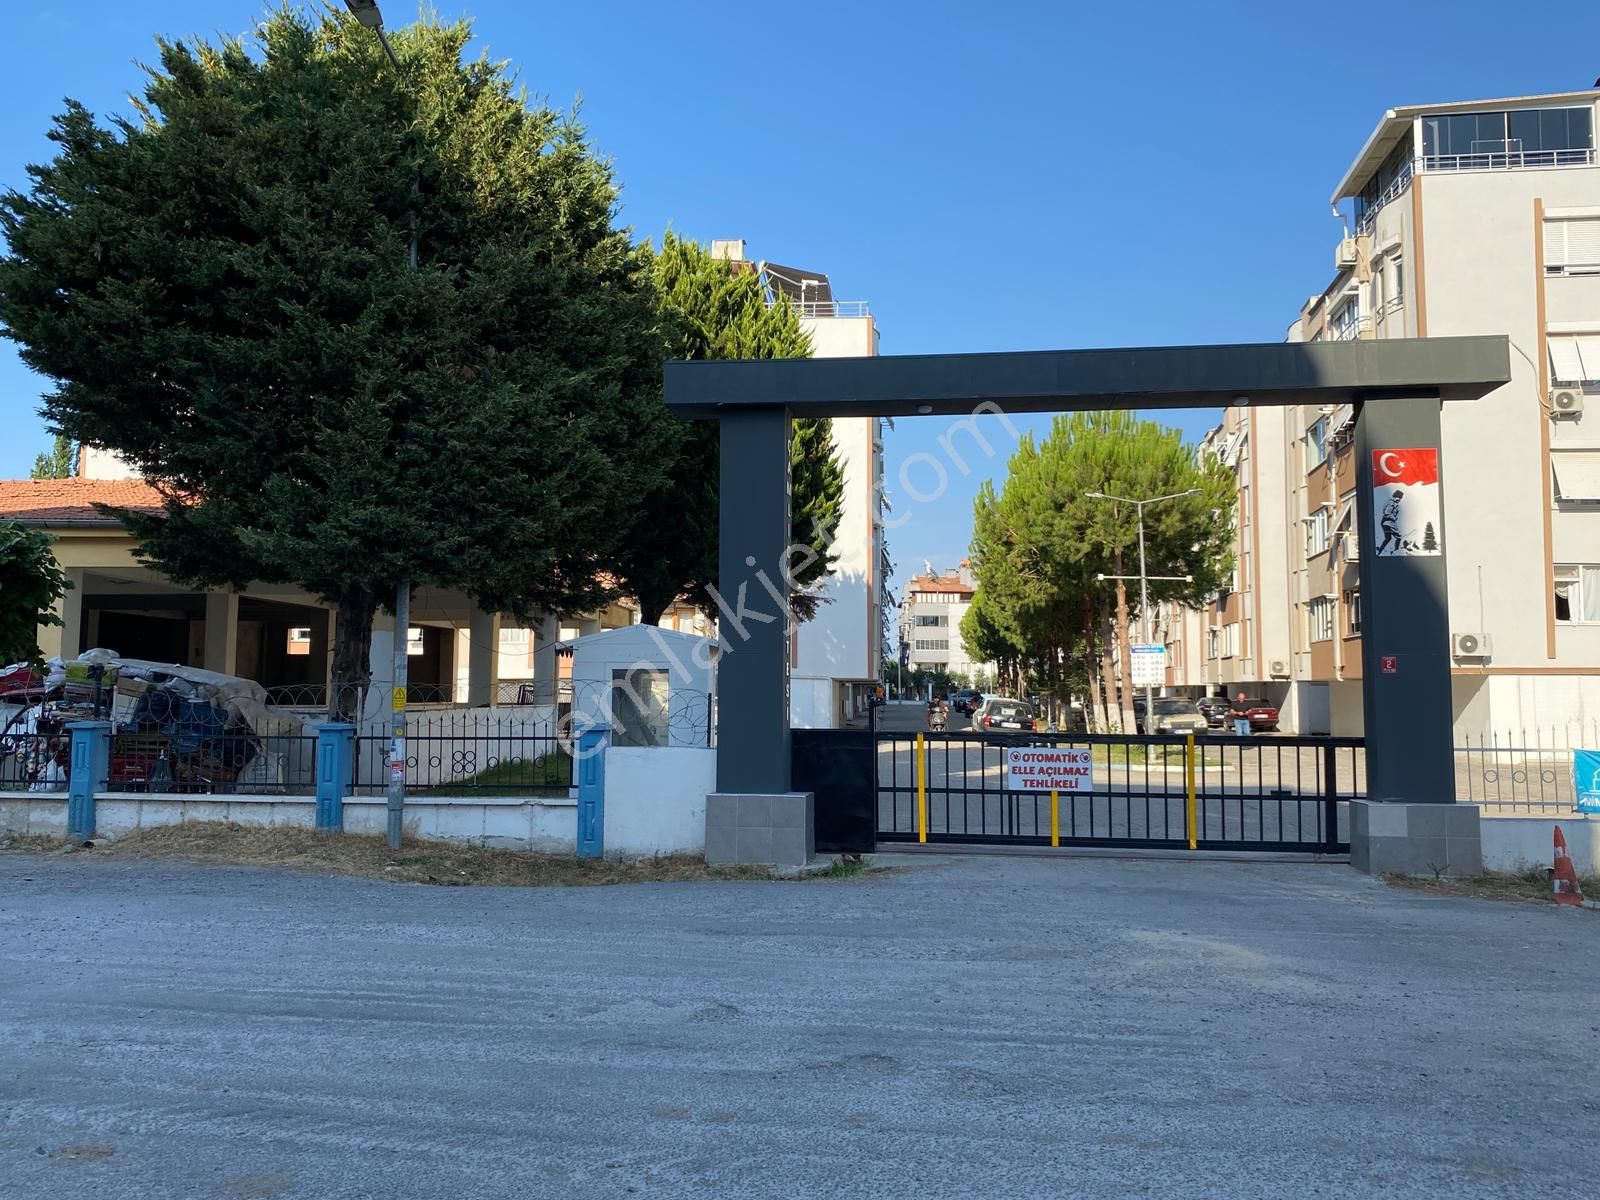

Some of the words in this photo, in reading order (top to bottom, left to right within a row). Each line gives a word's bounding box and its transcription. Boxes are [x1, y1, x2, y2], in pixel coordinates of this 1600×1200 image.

[1022, 752, 1078, 763] OTOMATİK
[1011, 766, 1036, 775] ELLE
[1037, 766, 1089, 777] AÇILMAZ
[1022, 778, 1079, 788] TEHLİKELİ
